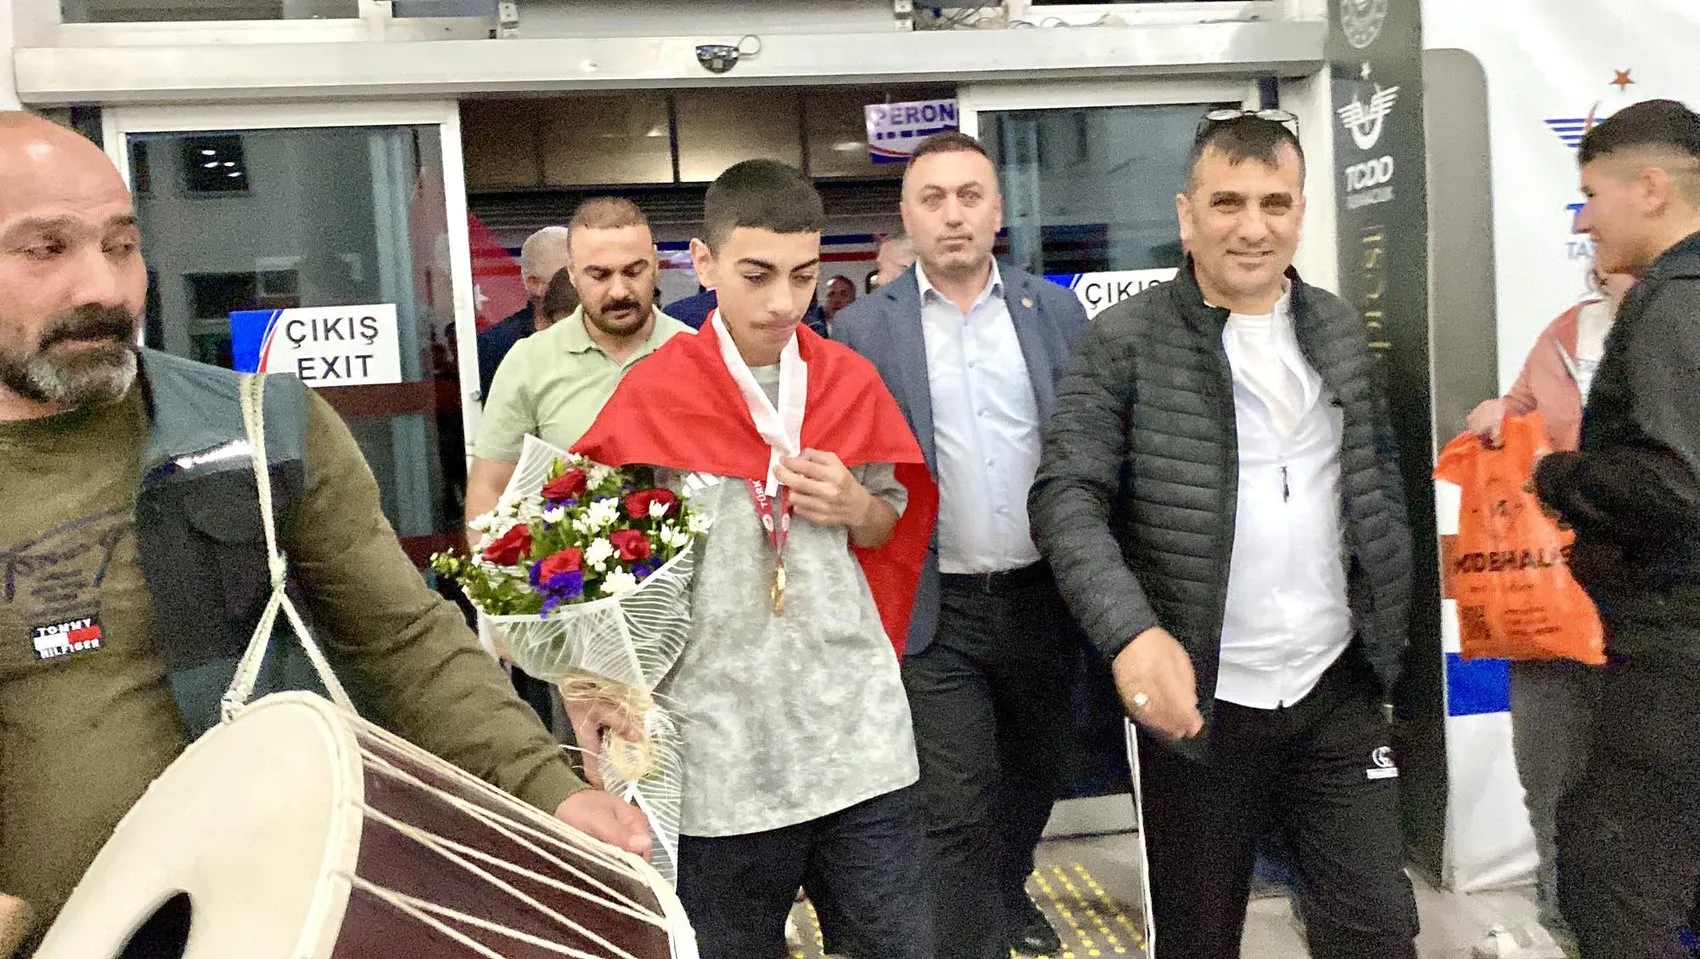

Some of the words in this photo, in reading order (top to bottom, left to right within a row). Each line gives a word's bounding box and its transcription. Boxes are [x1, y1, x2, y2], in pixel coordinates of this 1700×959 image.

[1085, 279, 1161, 309] ÇIK
[285, 316, 379, 350] ÇIKIŞ
[297, 354, 374, 380] EXIT
[37, 618, 91, 637] TOMMY
